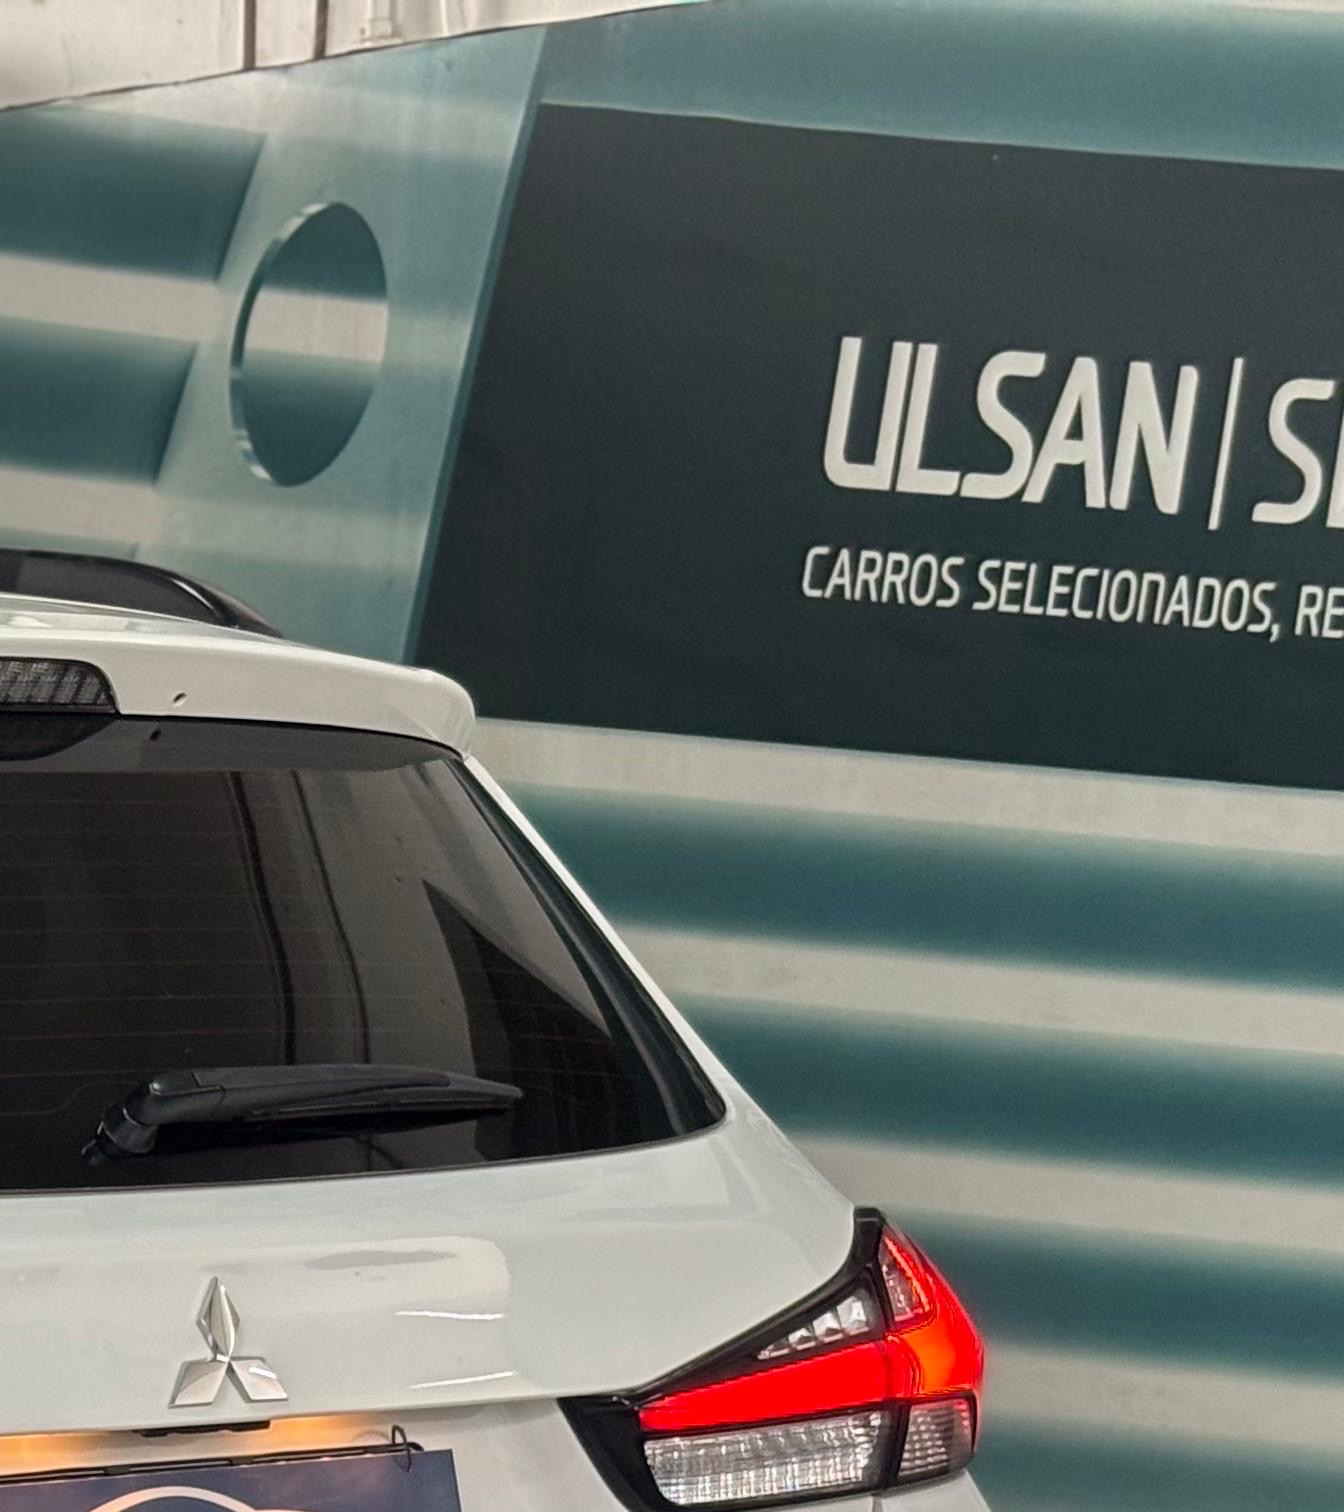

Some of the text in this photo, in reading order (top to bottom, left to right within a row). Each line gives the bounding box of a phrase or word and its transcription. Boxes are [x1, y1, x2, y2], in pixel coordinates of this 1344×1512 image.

[824, 336, 1199, 515] ULSAN
[802, 544, 965, 609] CARROS
[972, 558, 1282, 642] SELECIONADOS,
